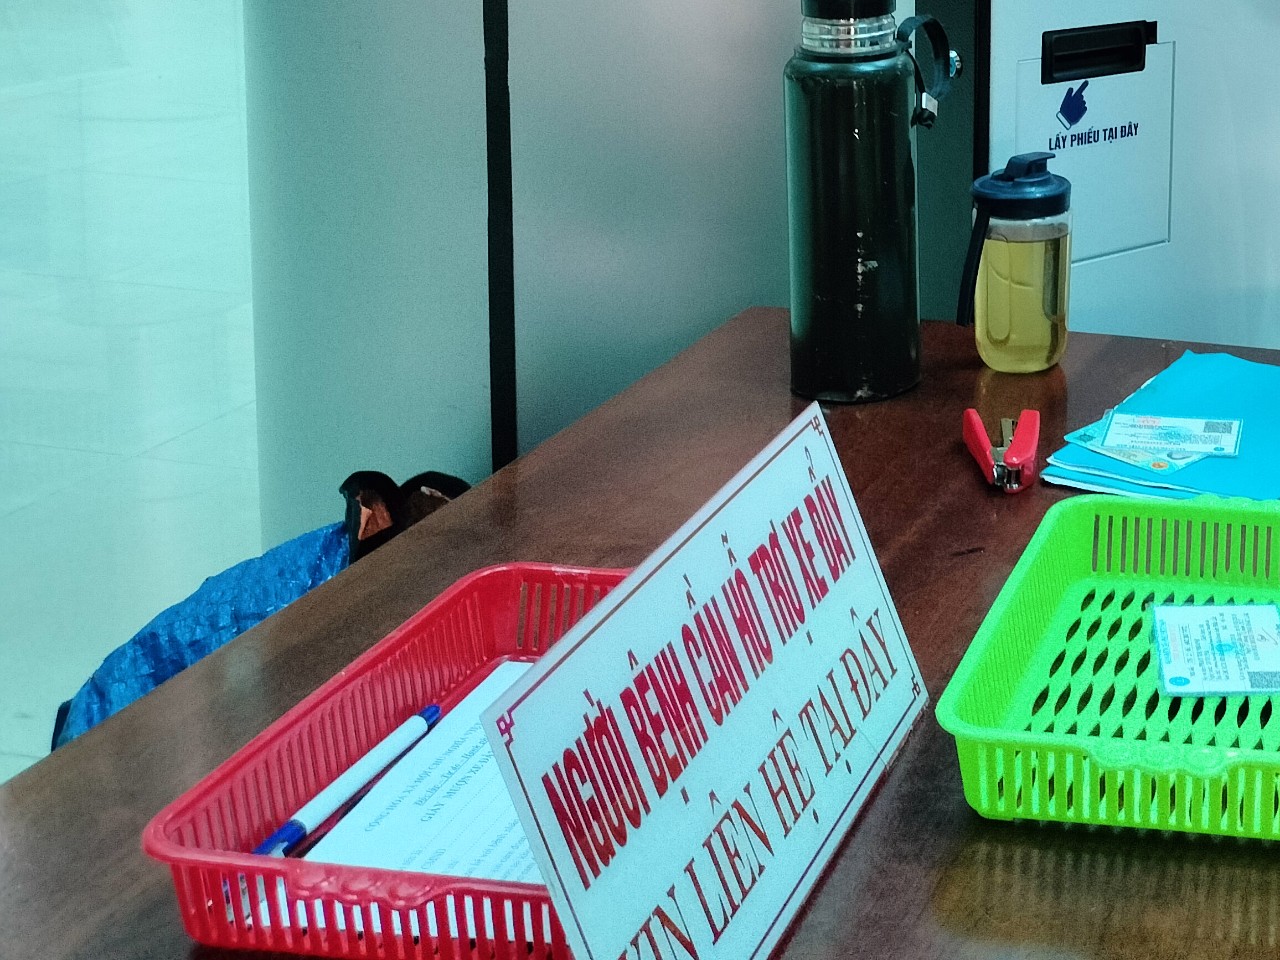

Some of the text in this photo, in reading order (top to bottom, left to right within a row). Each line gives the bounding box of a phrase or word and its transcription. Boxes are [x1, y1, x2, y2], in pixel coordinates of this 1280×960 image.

[1049, 121, 1139, 150] LẤY PHIẾU TẠI ĐÂY
[540, 446, 858, 891] NGƯỜI BỆNH CẦN HỖ TRỢ XE ĐẨY
[617, 607, 899, 960] IN LIÊN HỆ TẠI ĐÂY
